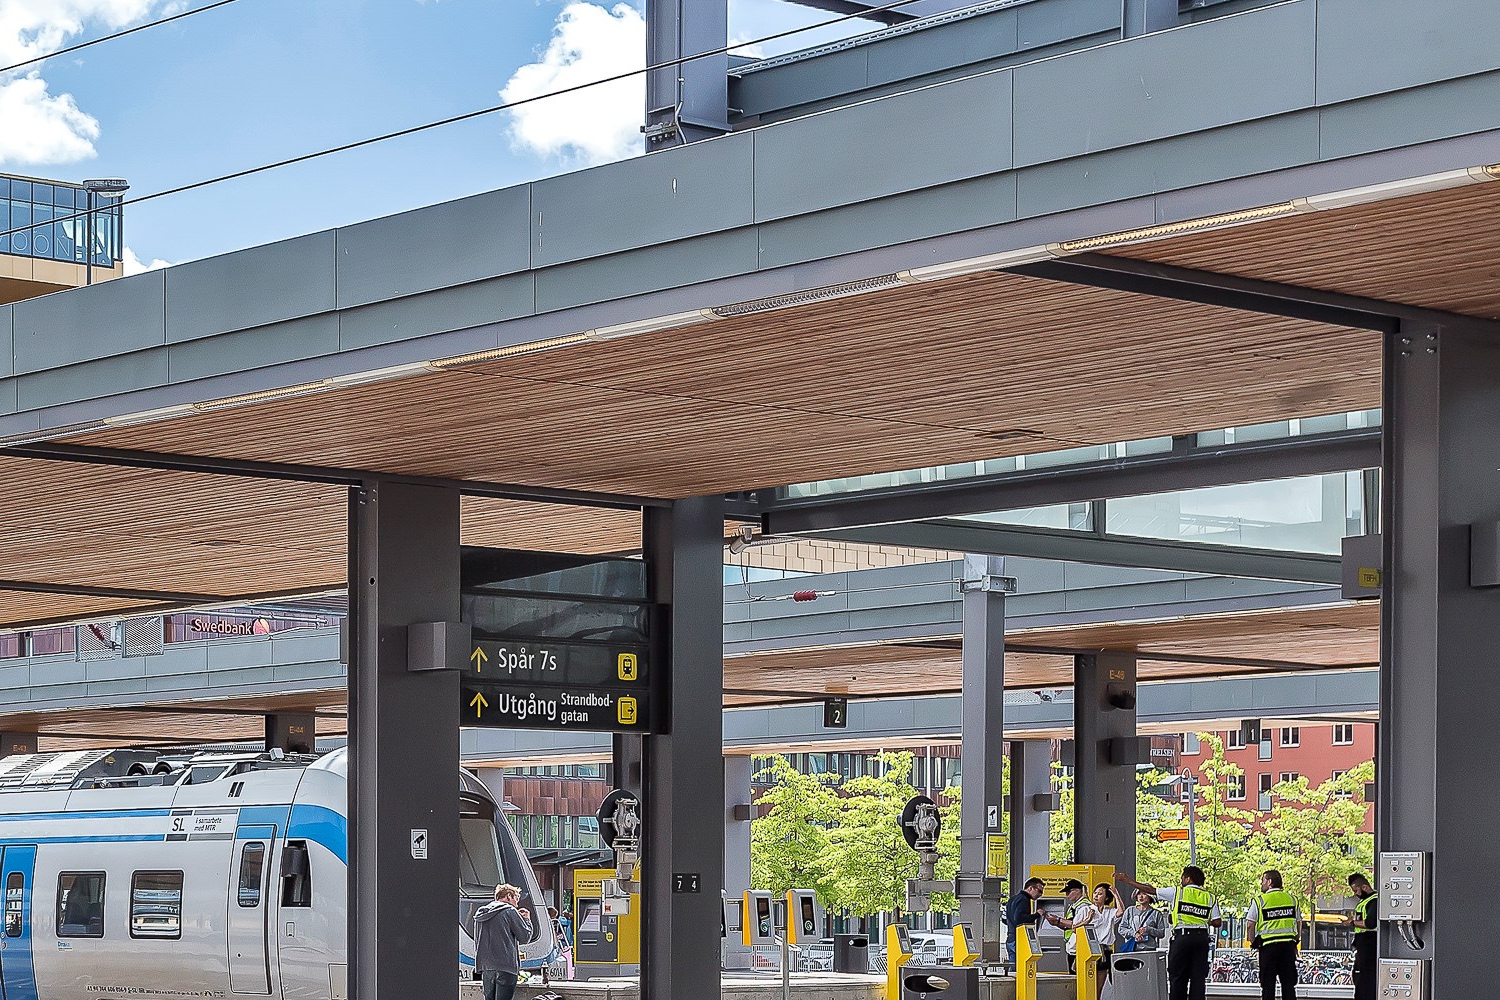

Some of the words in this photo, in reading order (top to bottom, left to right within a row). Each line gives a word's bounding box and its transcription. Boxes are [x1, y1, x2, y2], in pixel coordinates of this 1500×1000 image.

[193, 618, 252, 635] Swedbank
[498, 647, 535, 674] Spår
[539, 650, 557, 671] 7s
[499, 692, 557, 721] Utgång
[560, 692, 614, 707] Strandbod-
[560, 711, 589, 725] gatan
[834, 710, 841, 724] 2
[1250, 728, 1255, 741] 1
[171, 817, 185, 832] SL
[677, 880, 682, 889] 7
[691, 880, 697, 890] 4
